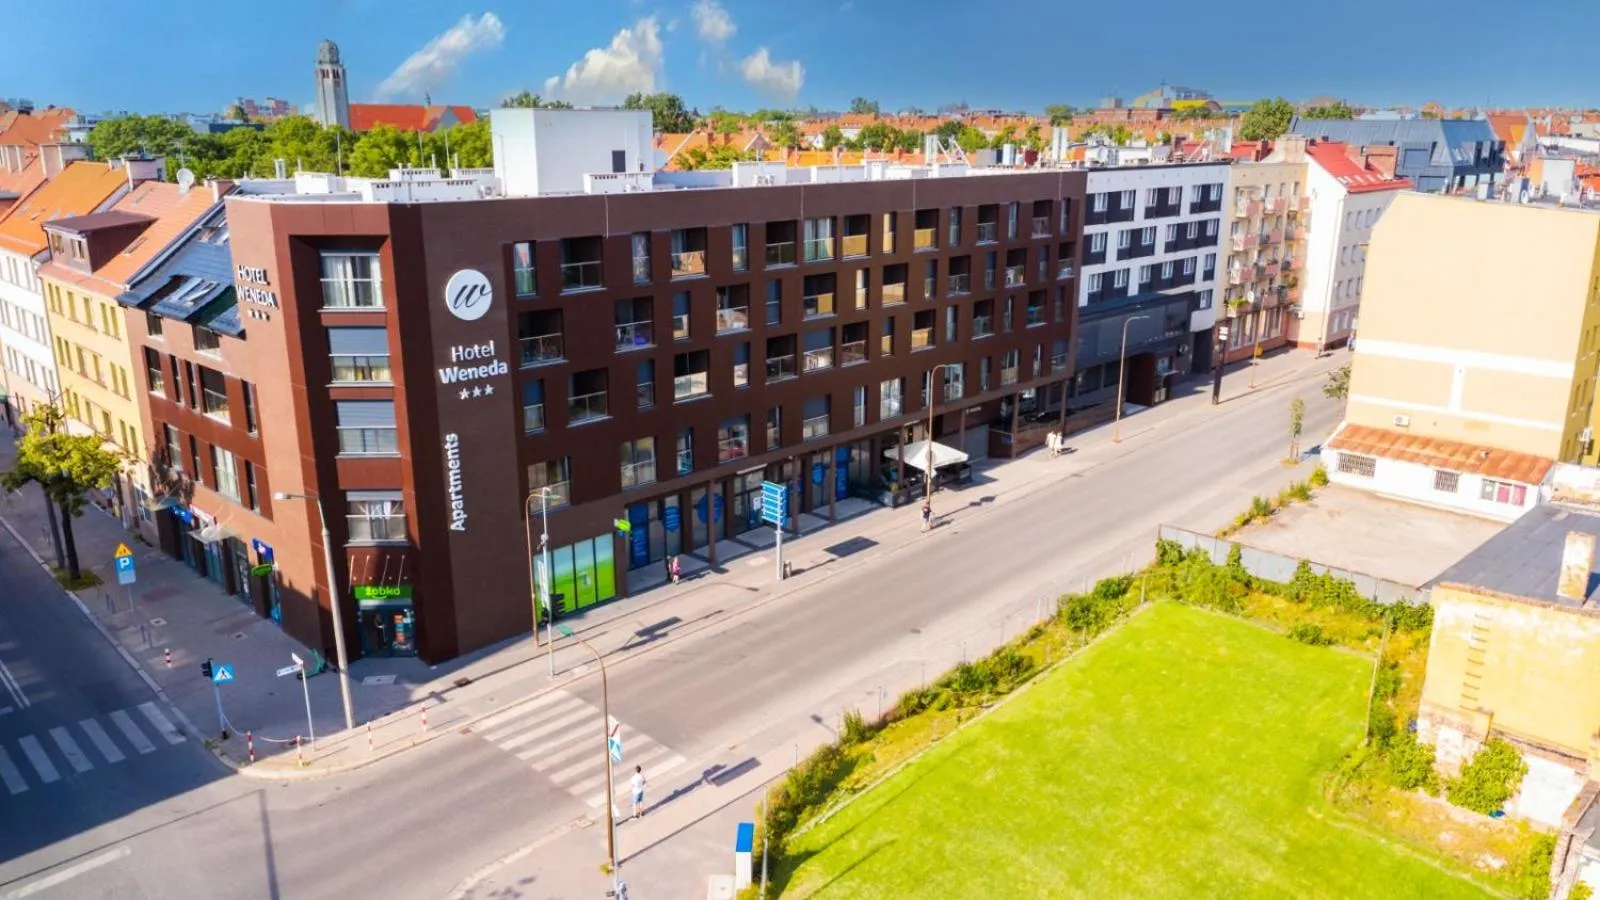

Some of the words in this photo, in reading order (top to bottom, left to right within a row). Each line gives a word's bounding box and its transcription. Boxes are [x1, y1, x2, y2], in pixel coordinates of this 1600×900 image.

[237, 264, 269, 286] HOTEL
[235, 284, 277, 309] WENEDA
[451, 339, 495, 363] Hotel
[438, 359, 509, 384] Weneda
[445, 433, 467, 531] Apartments
[120, 557, 130, 569] P
